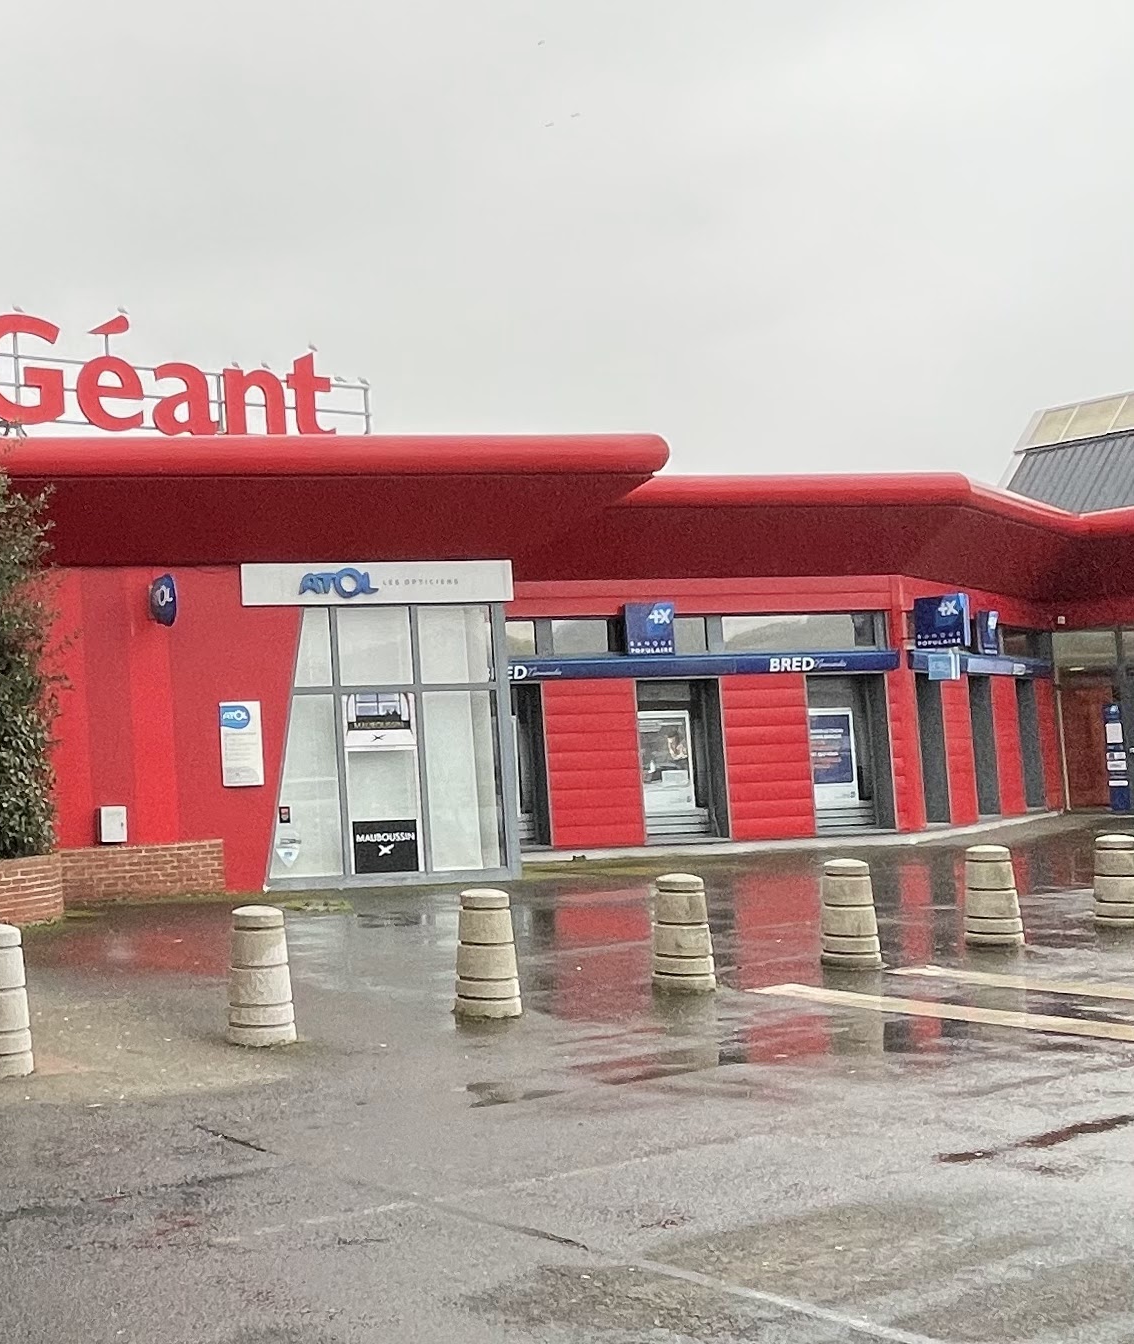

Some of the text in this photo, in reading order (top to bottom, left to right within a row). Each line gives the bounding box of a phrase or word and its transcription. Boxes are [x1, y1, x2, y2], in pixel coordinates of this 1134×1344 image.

[298, 567, 379, 598] ATOL
[769, 657, 815, 672] BRED
[222, 710, 248, 721] ATOL
[356, 832, 416, 843] MAUBOUSSIN
